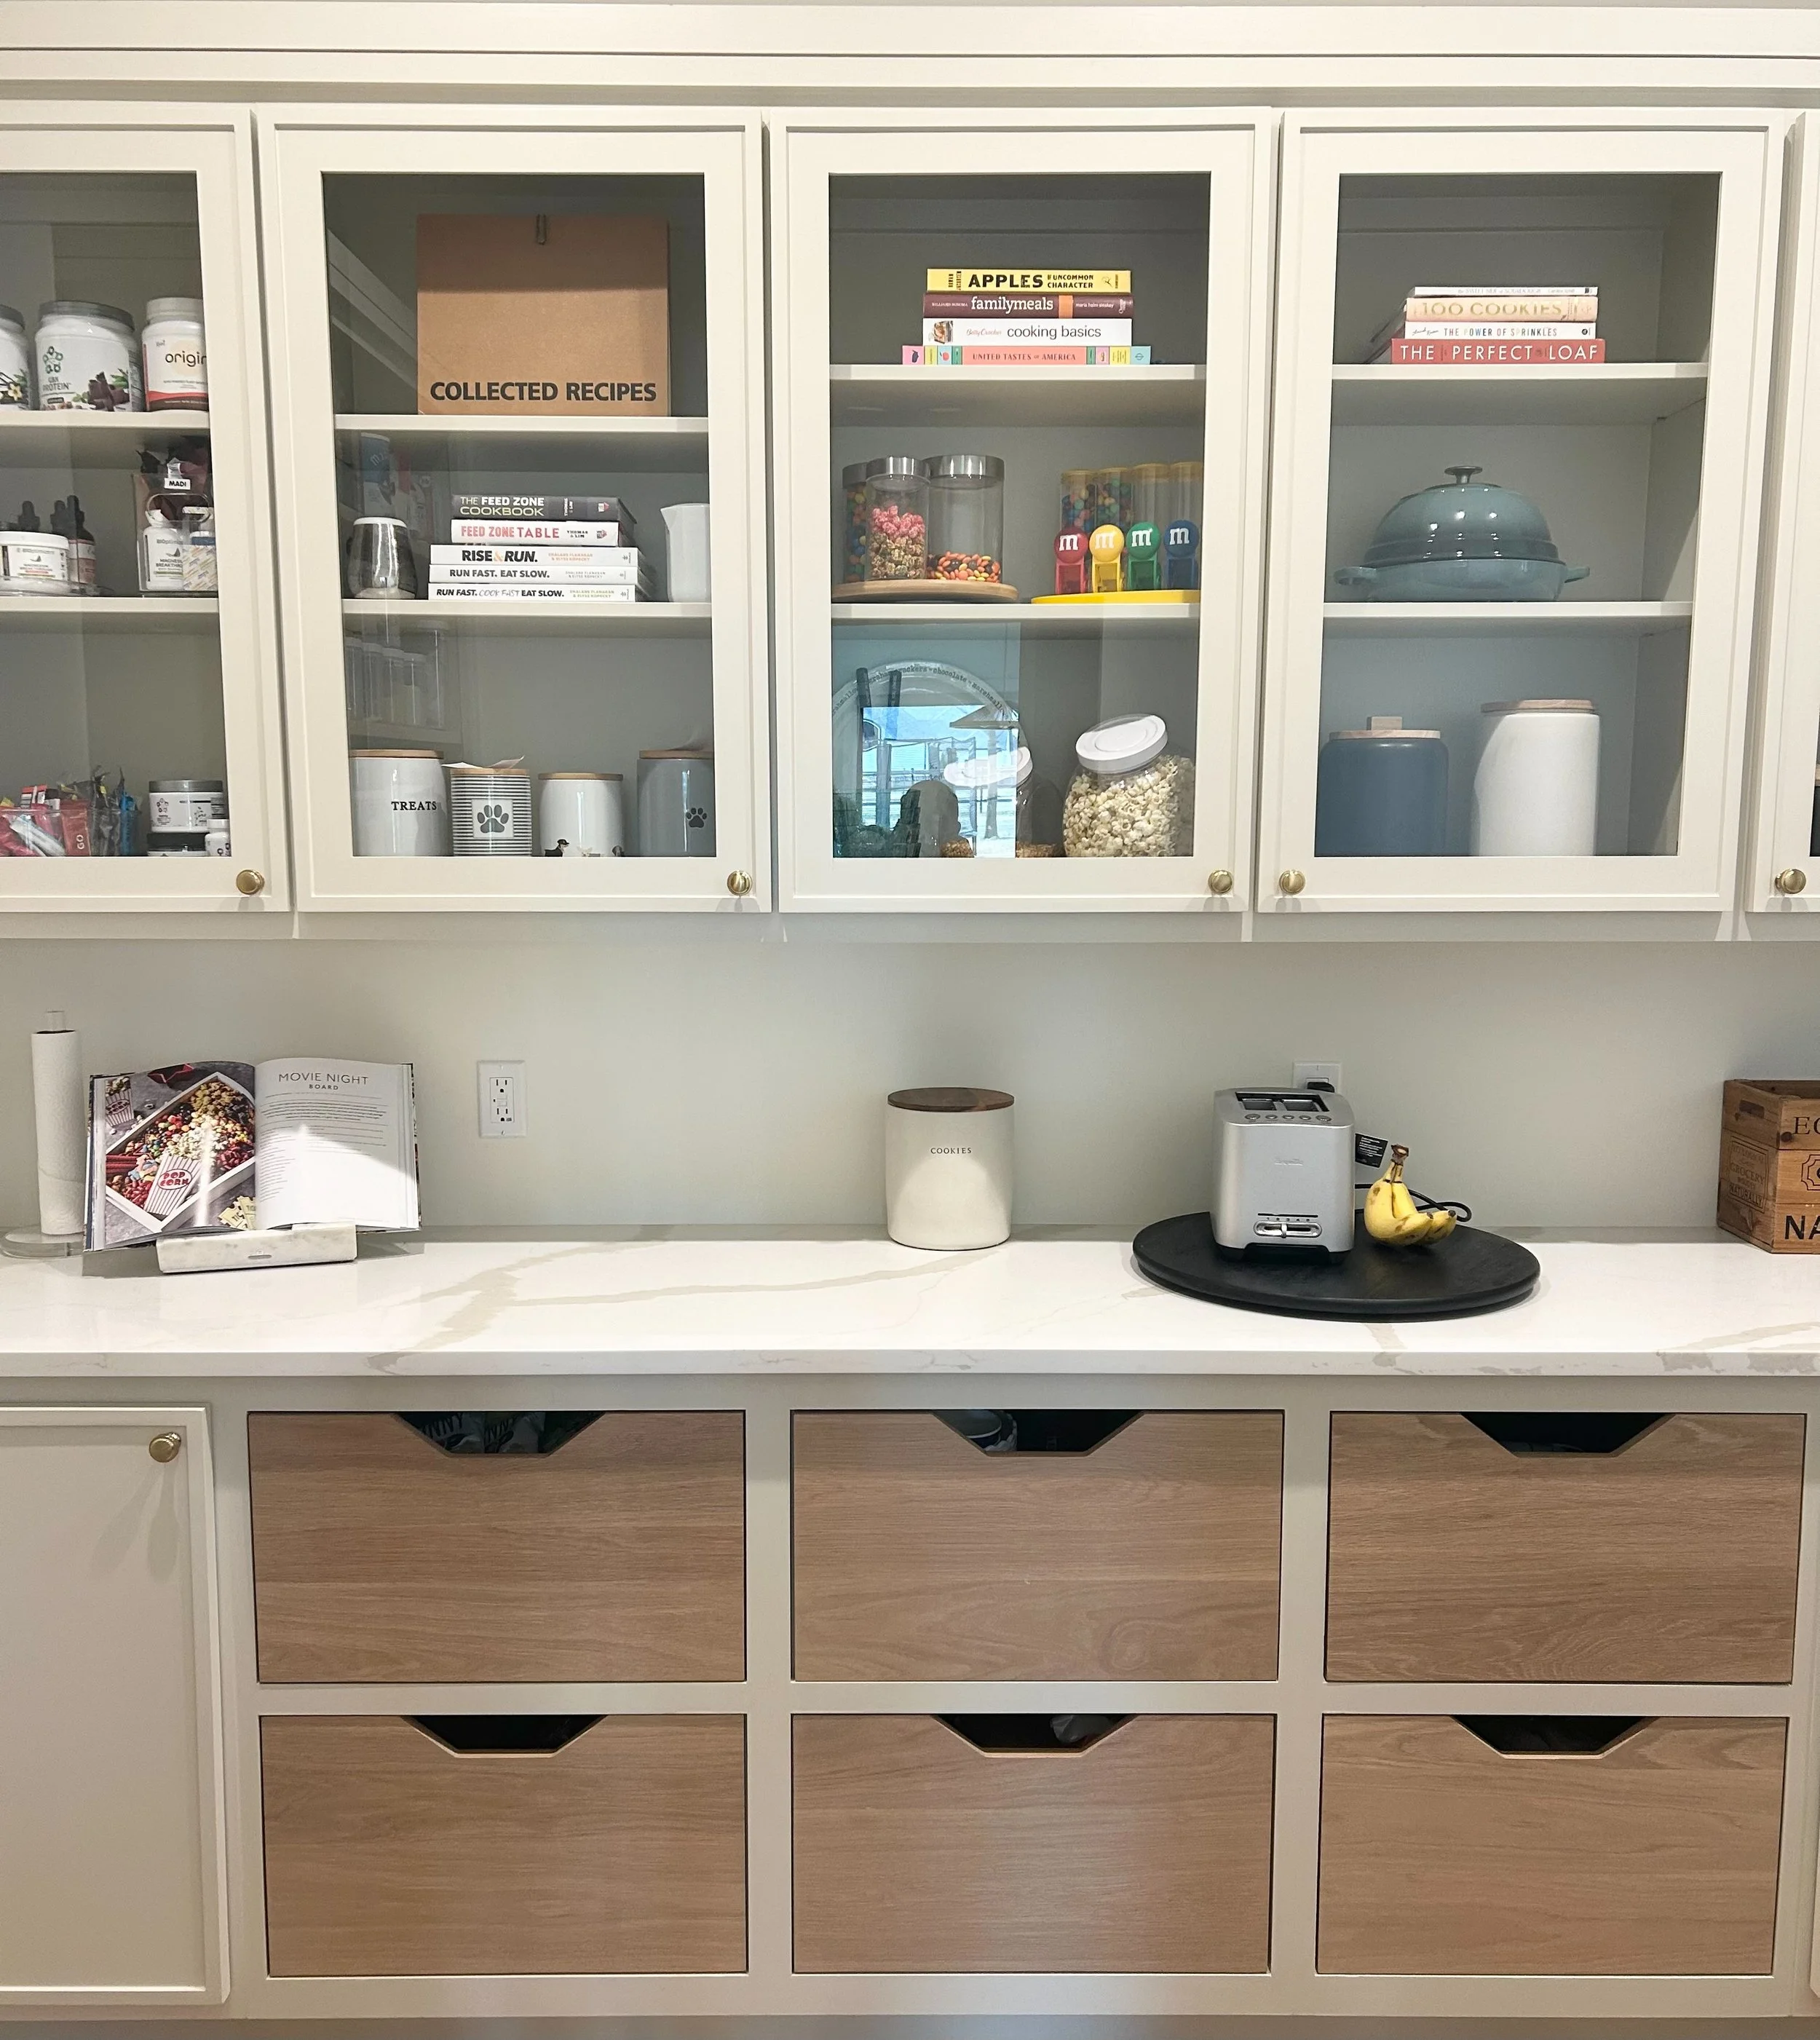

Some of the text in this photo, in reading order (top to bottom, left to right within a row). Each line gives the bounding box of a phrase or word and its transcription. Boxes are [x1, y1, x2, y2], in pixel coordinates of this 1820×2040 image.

[968, 274, 1043, 288] APPLES
[971, 296, 1053, 314] familymeals
[1422, 302, 1463, 315] 100
[1471, 302, 1562, 315] COOKIES
[1008, 325, 1056, 340] cooking
[1061, 325, 1101, 337] basics
[1401, 345, 1597, 360] THE PERFECT LOAF
[430, 382, 657, 400] COLLECTED RECIPES
[460, 497, 545, 506] THE FEED ZONE
[460, 506, 545, 516] COOKBOOK
[461, 526, 560, 539] FEED ZONE TABLE
[1131, 529, 1152, 547] m
[1170, 528, 1190, 545] m
[1059, 534, 1079, 551] m
[1095, 532, 1115, 549] m
[462, 550, 493, 561] RISE
[504, 550, 538, 562] RUN.
[472, 569, 497, 577] FAST.
[391, 801, 437, 810] TREATS
[279, 1072, 369, 1085] MOVIE NIGHT
[163, 1171, 186, 1179] POP
[1730, 1163, 1765, 1185] GROCERY
[159, 1178, 189, 1187] CORN
